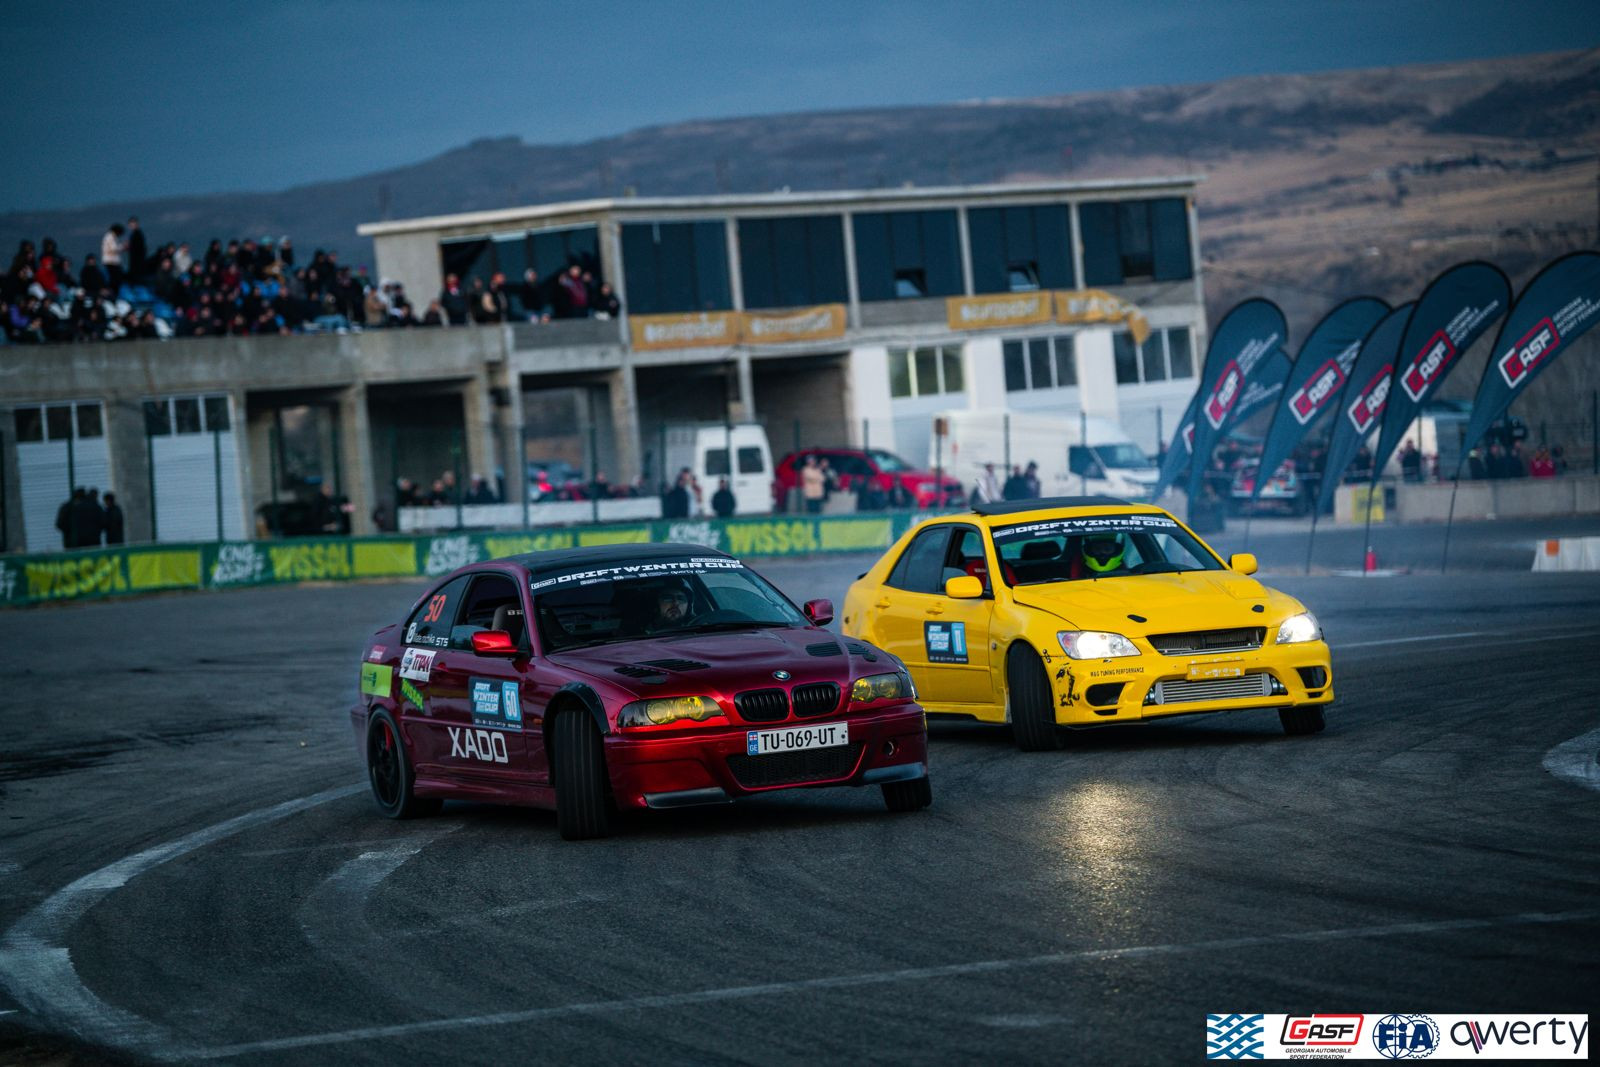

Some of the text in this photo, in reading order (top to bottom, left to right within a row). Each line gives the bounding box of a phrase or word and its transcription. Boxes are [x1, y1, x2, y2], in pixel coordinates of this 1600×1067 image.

[1015, 521, 1071, 533] DRIFT
[1072, 519, 1141, 527] WINTER
[727, 523, 817, 554] WISSOL
[557, 567, 622, 583] DRIFT
[623, 562, 703, 573] WINTER
[424, 594, 446, 622] 50
[435, 636, 449, 647] STS
[474, 690, 498, 703] WINTER
[505, 690, 518, 718] 50
[484, 702, 498, 713] CUP
[447, 726, 509, 764] XADO
[749, 744, 758, 752] GE
[760, 727, 836, 751] TU-069-UT
